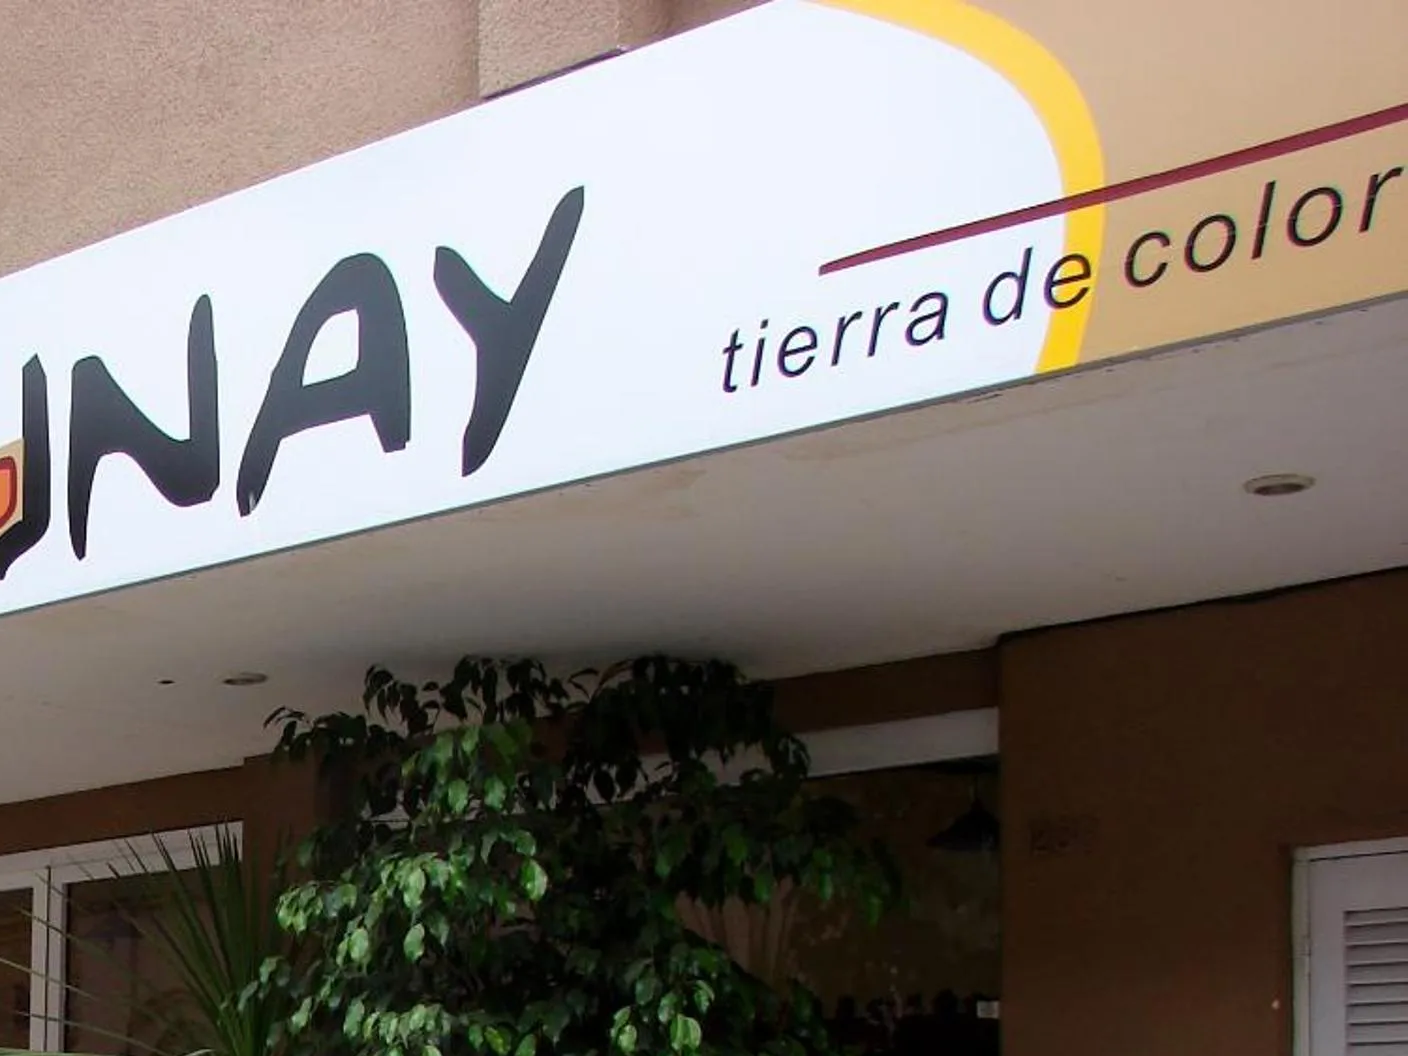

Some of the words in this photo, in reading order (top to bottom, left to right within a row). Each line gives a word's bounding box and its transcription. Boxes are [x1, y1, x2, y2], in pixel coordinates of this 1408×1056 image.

[722, 290, 950, 393] tierra
[983, 247, 1092, 327] de
[1125, 166, 1406, 289] color
